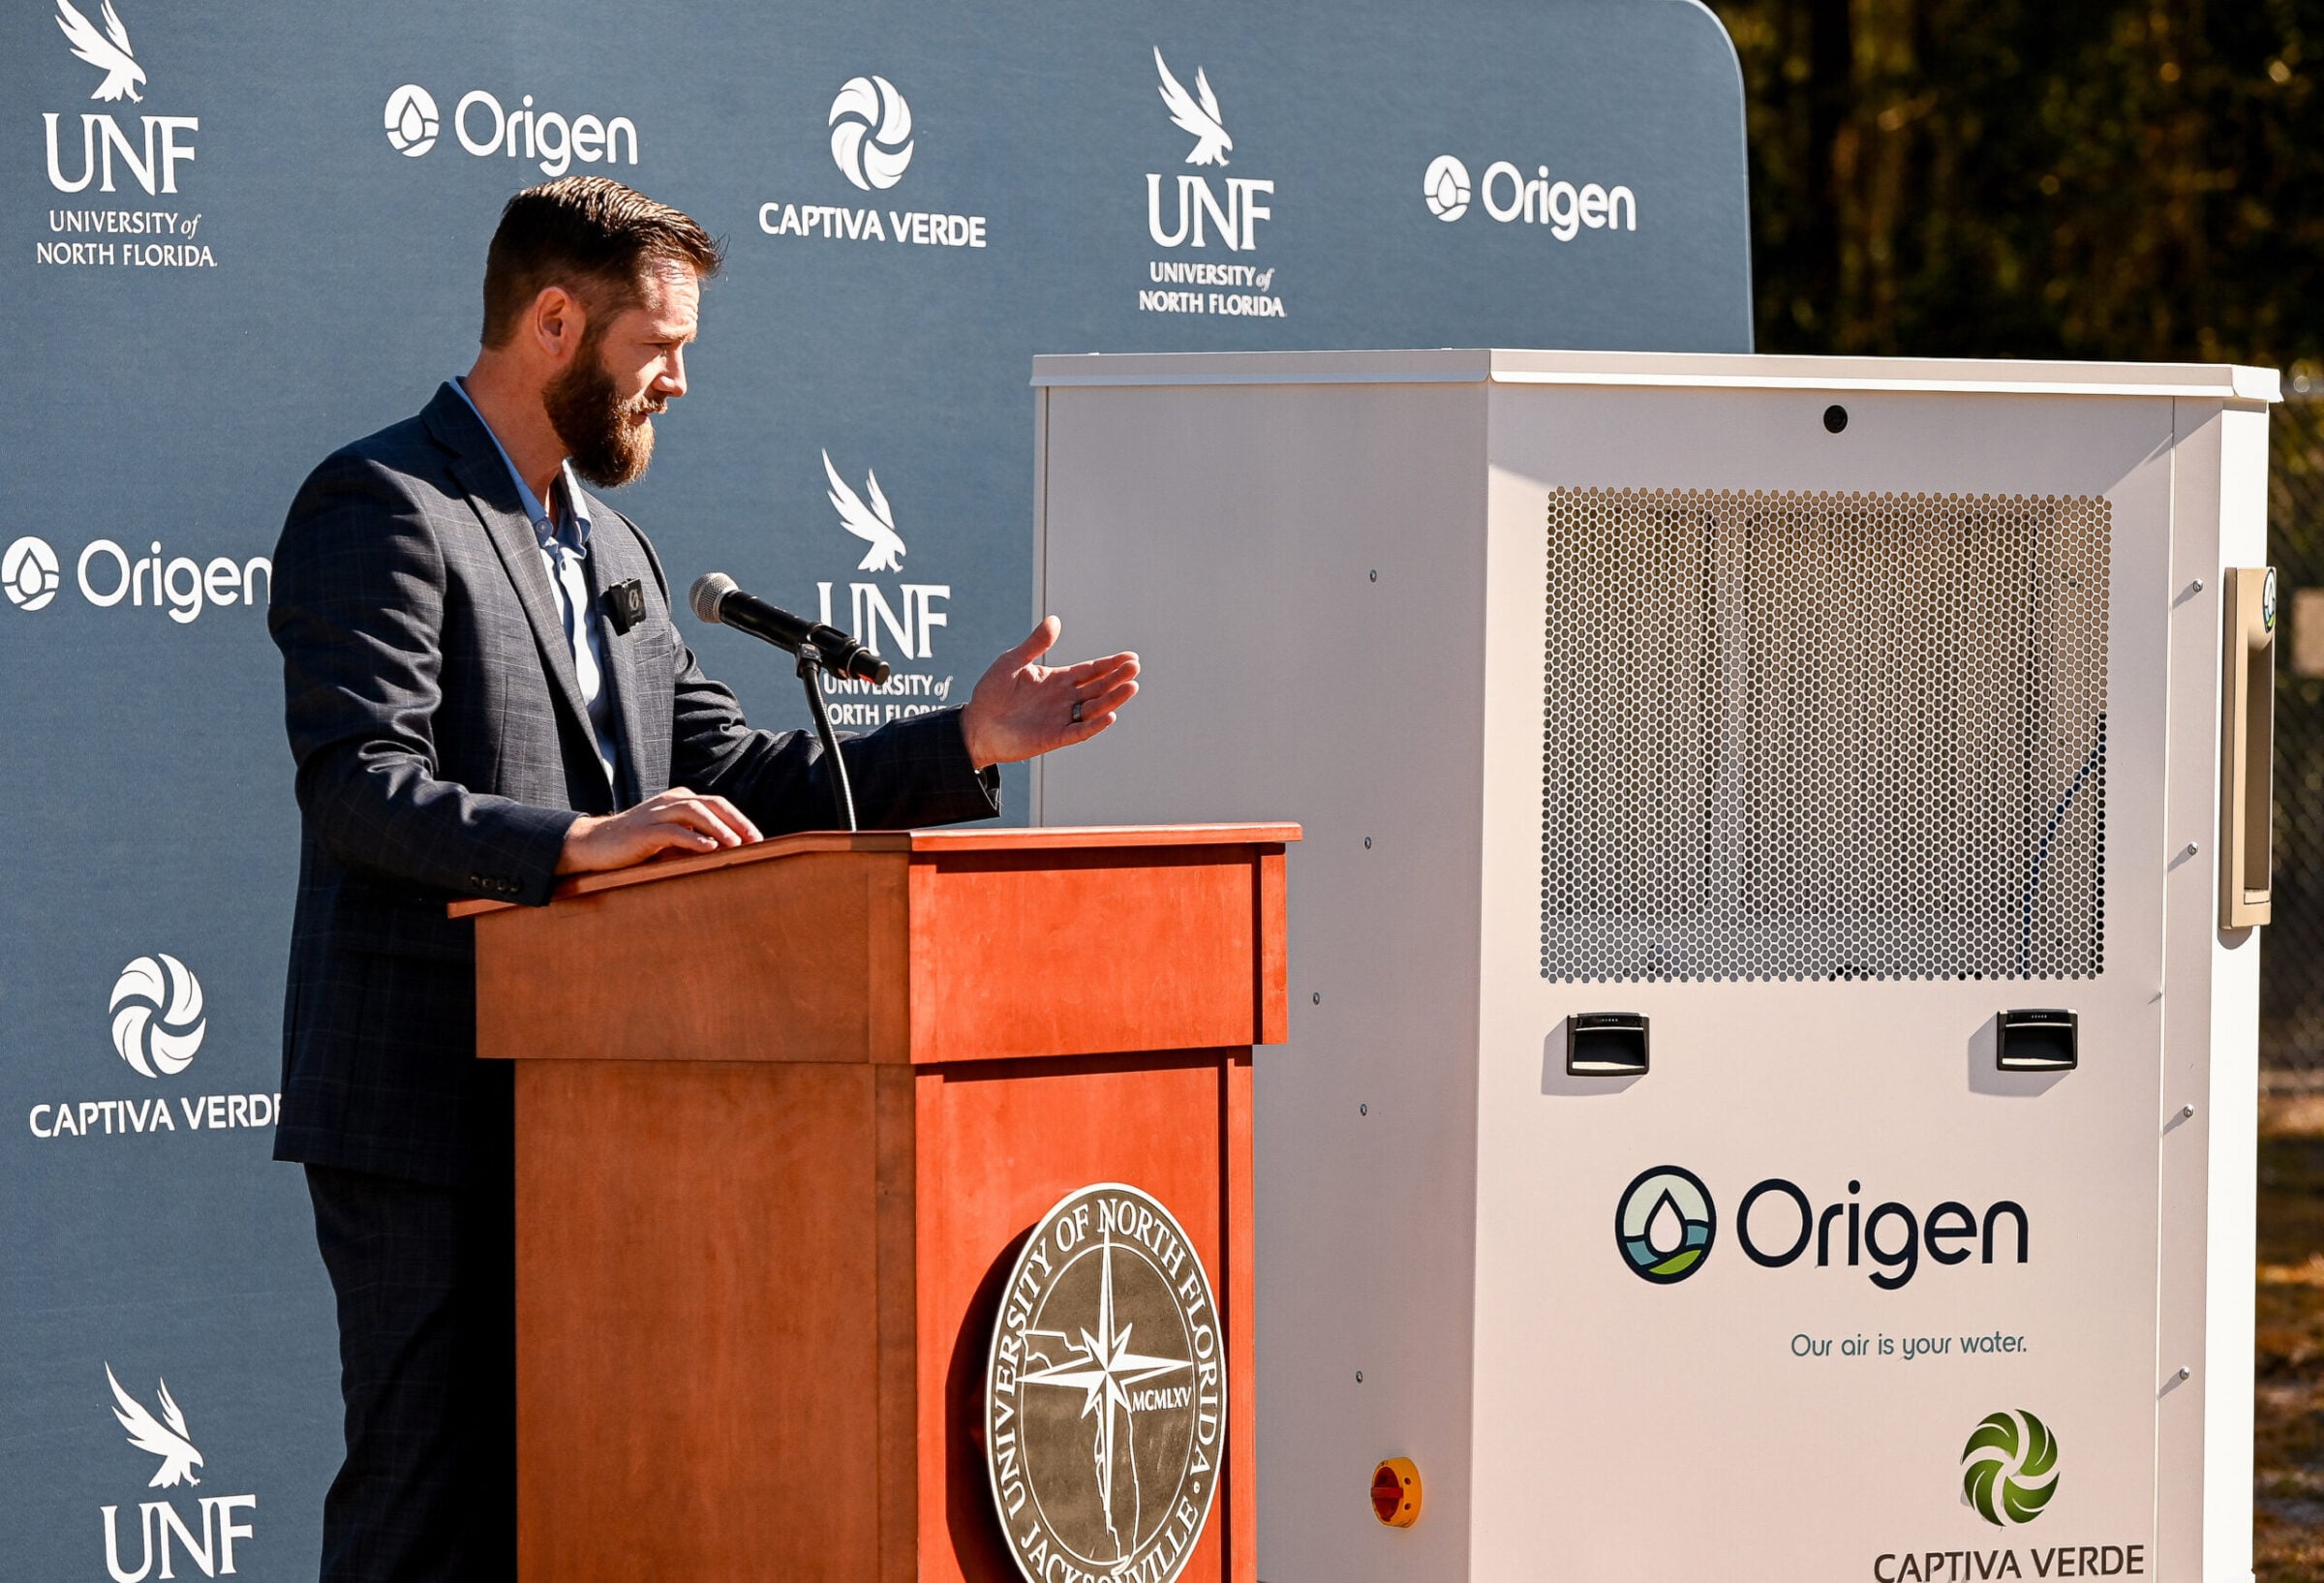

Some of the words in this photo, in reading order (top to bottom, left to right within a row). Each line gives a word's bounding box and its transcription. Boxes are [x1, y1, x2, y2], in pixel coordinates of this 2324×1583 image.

[455, 91, 638, 177] Origen
[42, 113, 199, 197] UNF
[1146, 173, 1274, 252] UNF
[1482, 161, 1636, 242] Origen
[49, 210, 178, 234] UNIVERSITY
[180, 213, 201, 240] of
[758, 201, 886, 242] CAPTIVA
[889, 211, 987, 248] VERDE
[37, 242, 115, 265] NORTH
[1149, 261, 1256, 287] UNIVERSITY
[1256, 268, 1275, 292] of
[1139, 290, 1204, 314] NORTH
[77, 539, 272, 624] Origen
[933, 675, 954, 701] of
[813, 704, 880, 725] ORTH
[29, 1098, 175, 1138] CAPTIVA
[1736, 1177, 2029, 1291] Origen
[994, 1238, 1054, 1520] UNIVERSITY
[1055, 1203, 1089, 1252] OF
[1096, 1199, 1186, 1280] NORTH
[1178, 1269, 1218, 1476] FLORIDA
[1791, 1334, 1833, 1356] Our
[1841, 1333, 1870, 1355] air
[1878, 1333, 1894, 1355] is
[1903, 1337, 1952, 1360] your
[1960, 1330, 2027, 1354] water.
[1132, 1386, 1192, 1412] MCMLXV
[100, 1494, 257, 1583] UNF
[1874, 1550, 2022, 1583] CAPTIVA
[2031, 1544, 2144, 1577] VERDE
